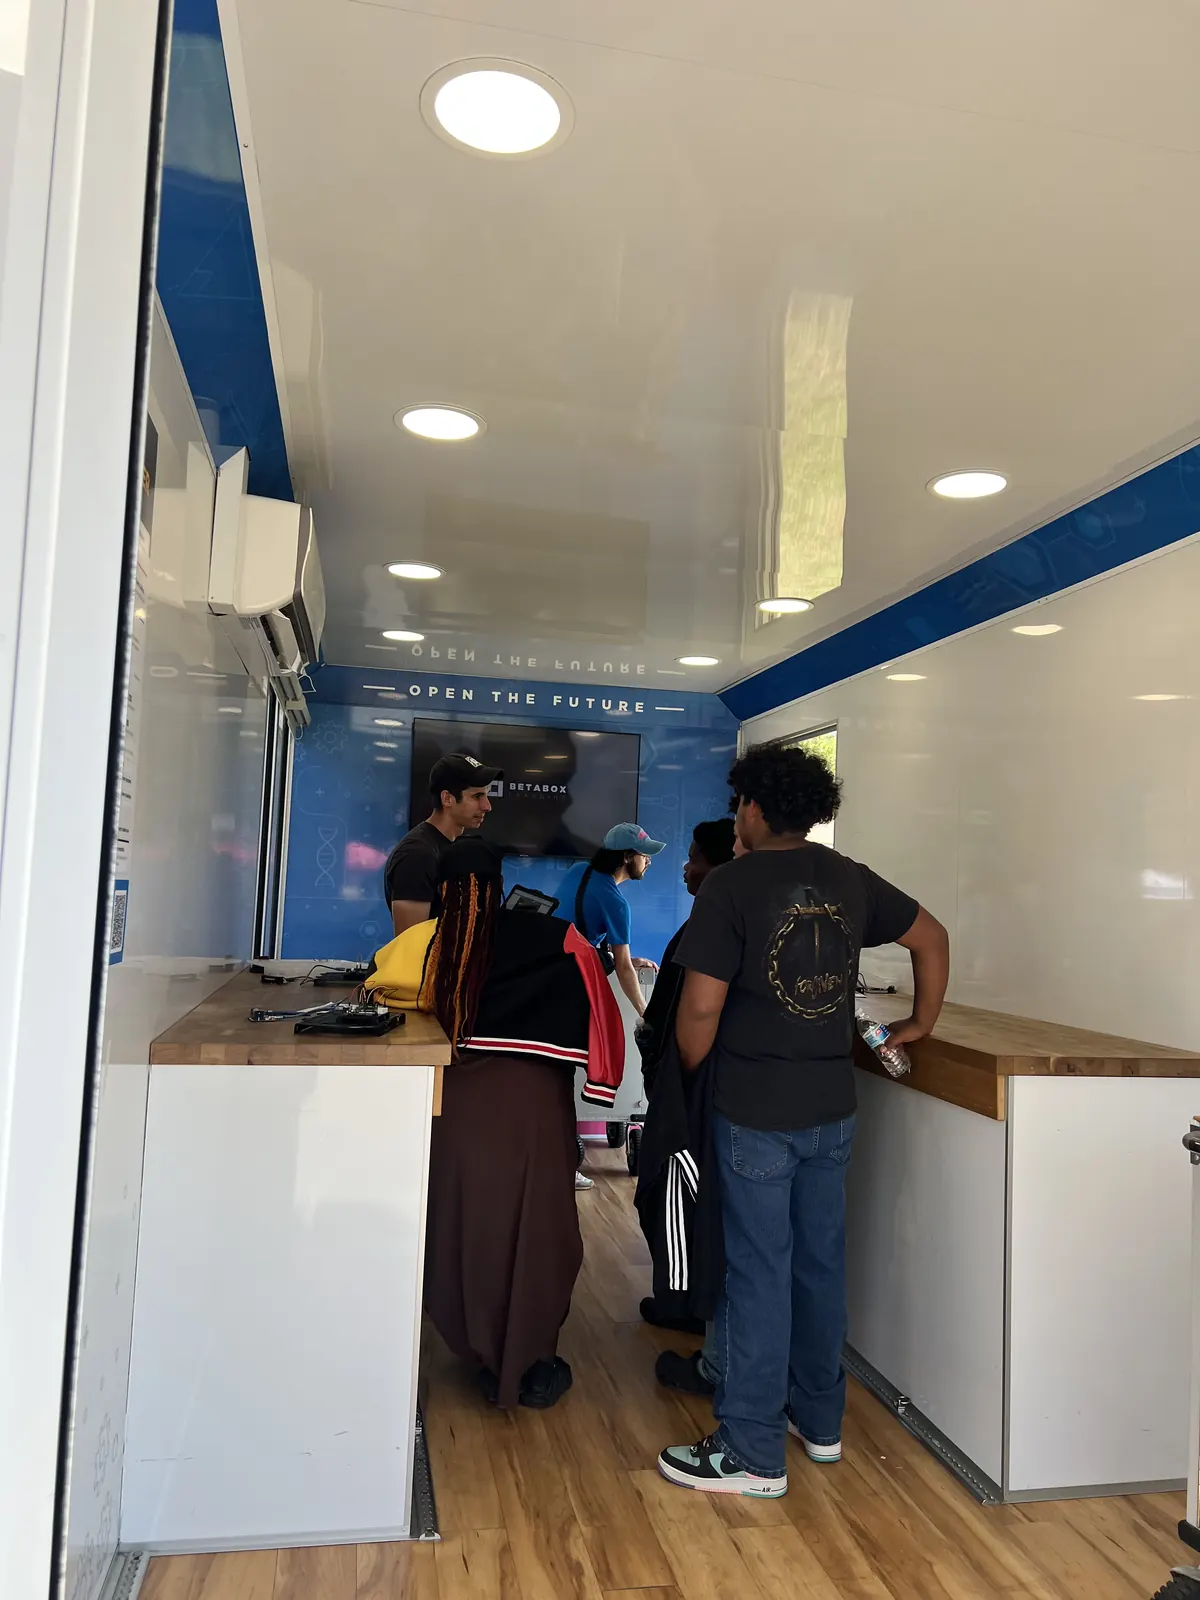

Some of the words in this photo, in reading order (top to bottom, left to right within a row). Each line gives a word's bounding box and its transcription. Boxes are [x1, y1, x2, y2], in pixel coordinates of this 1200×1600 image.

[409, 685, 474, 701] OPEN
[491, 690, 536, 705] THE
[552, 695, 645, 713] FUTURE
[509, 782, 567, 794] BETABOX
